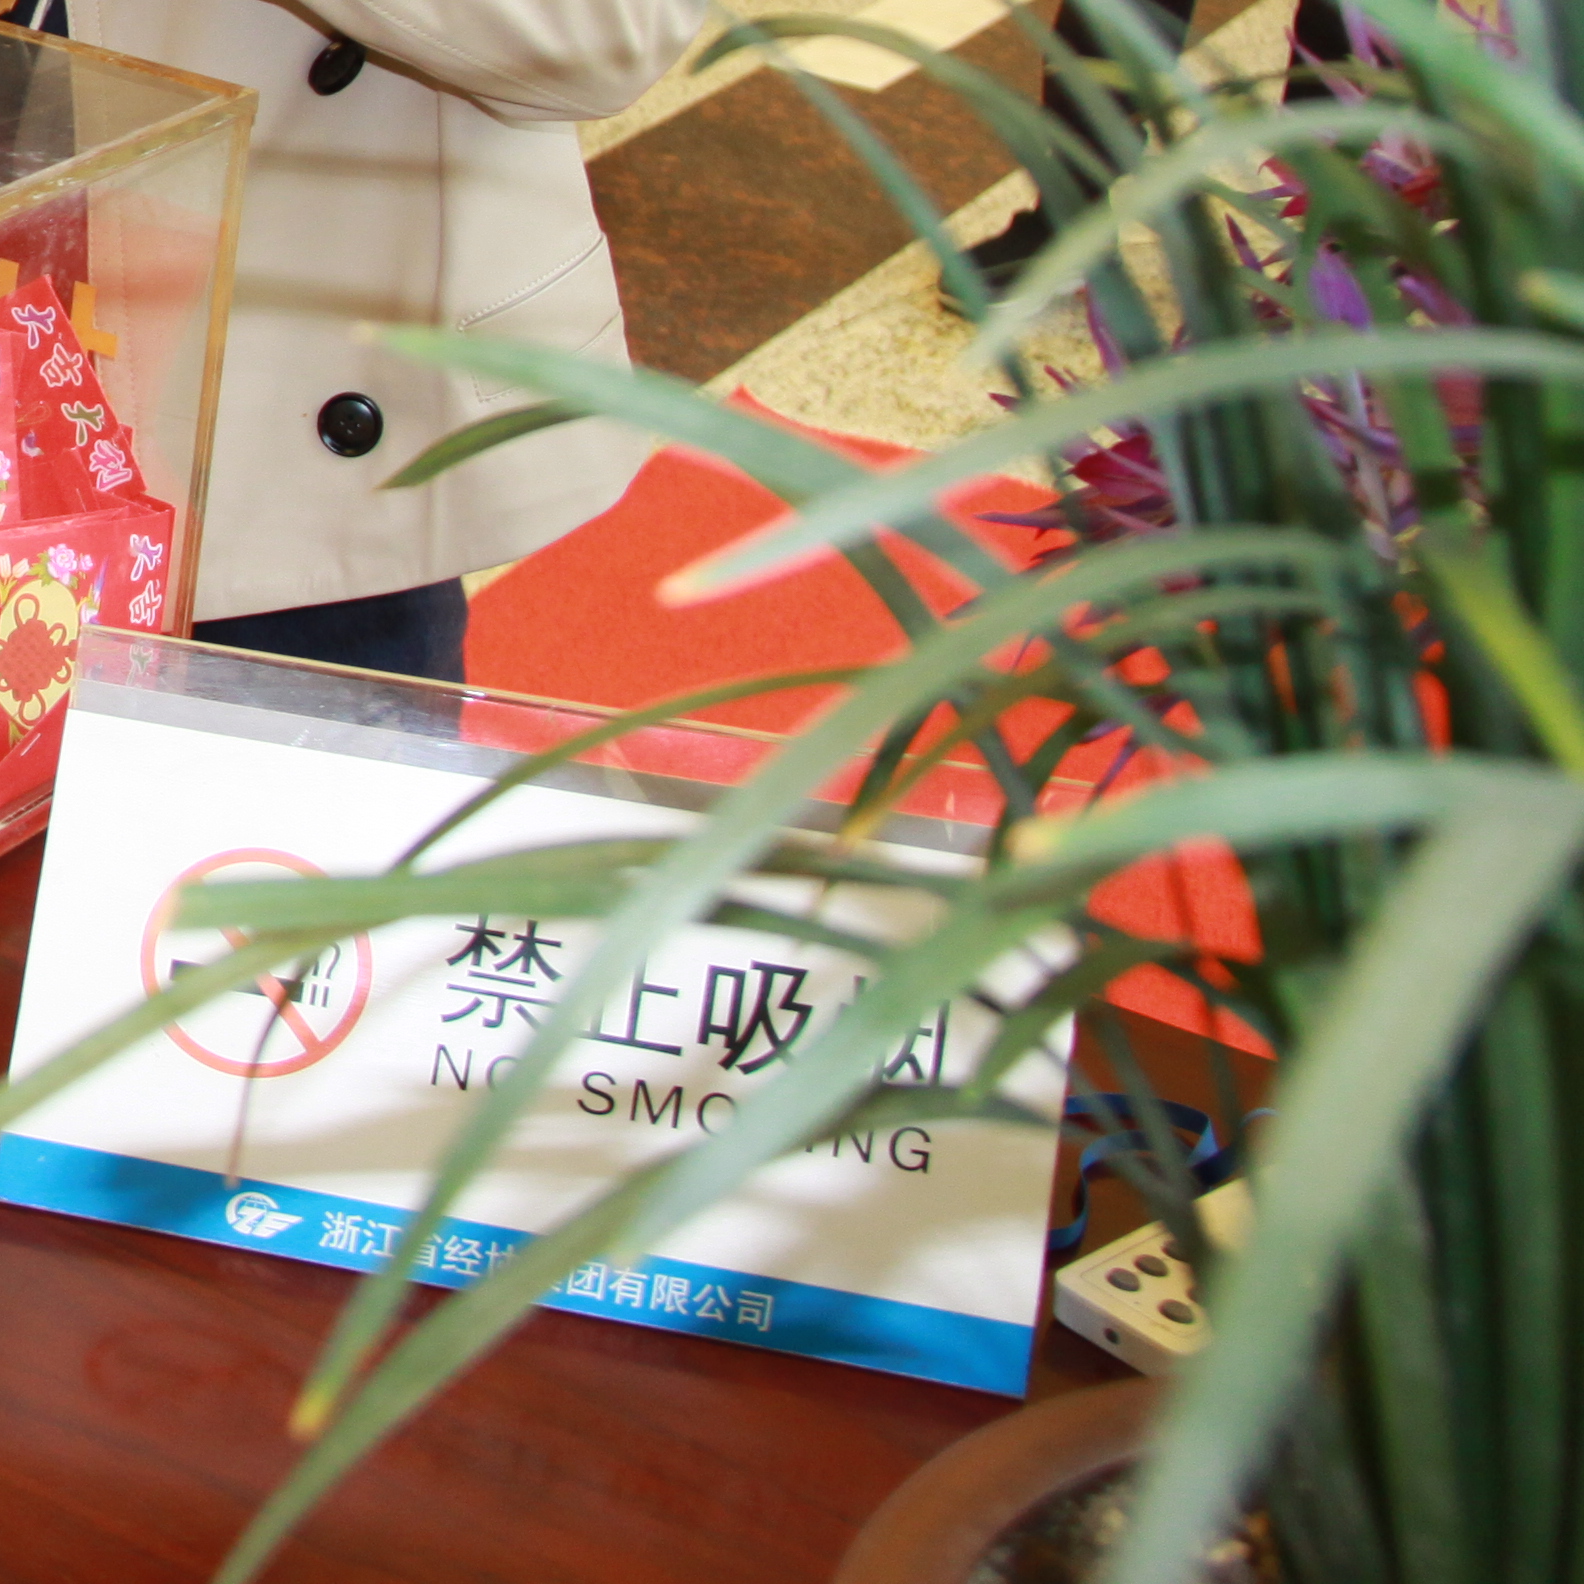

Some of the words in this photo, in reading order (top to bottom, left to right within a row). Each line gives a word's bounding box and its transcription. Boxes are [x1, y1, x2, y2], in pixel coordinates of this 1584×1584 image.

[10, 303, 133, 492] 大吉大利
[577, 1071, 932, 1174] SMONG
[318, 1210, 775, 1332] 浙江省经协团有限公司
